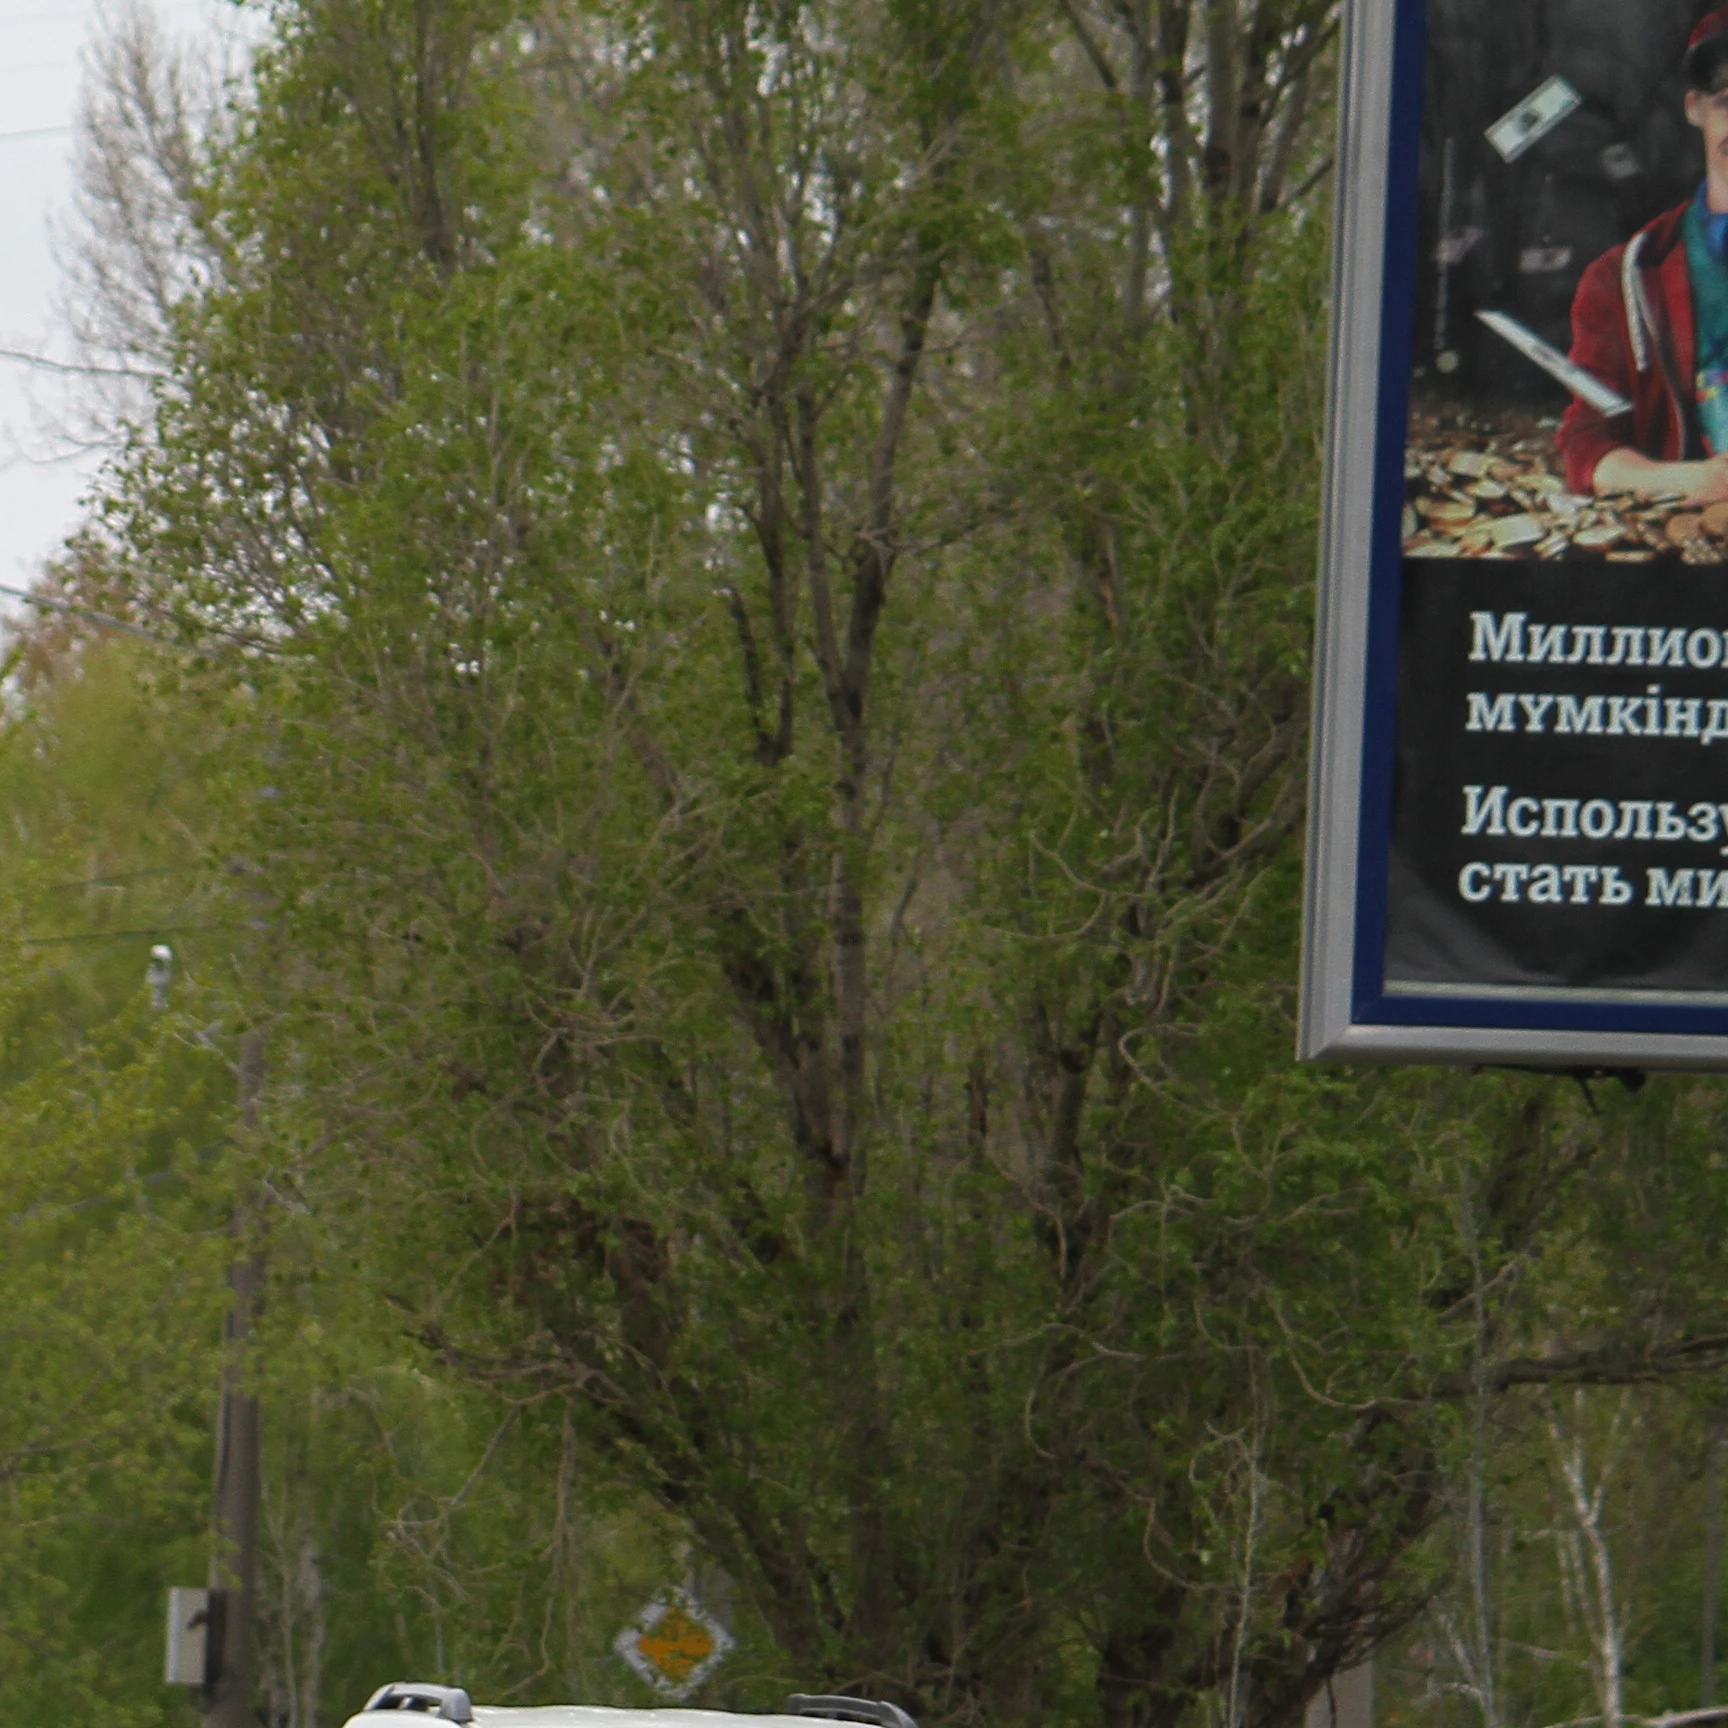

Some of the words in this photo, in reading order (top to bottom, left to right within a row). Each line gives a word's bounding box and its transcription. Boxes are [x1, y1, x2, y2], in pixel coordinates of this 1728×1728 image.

[1468, 611, 1728, 669] Миллио
[1461, 785, 1728, 856] Использ
[1458, 861, 1633, 904] стать
[1645, 867, 1728, 908] ми
